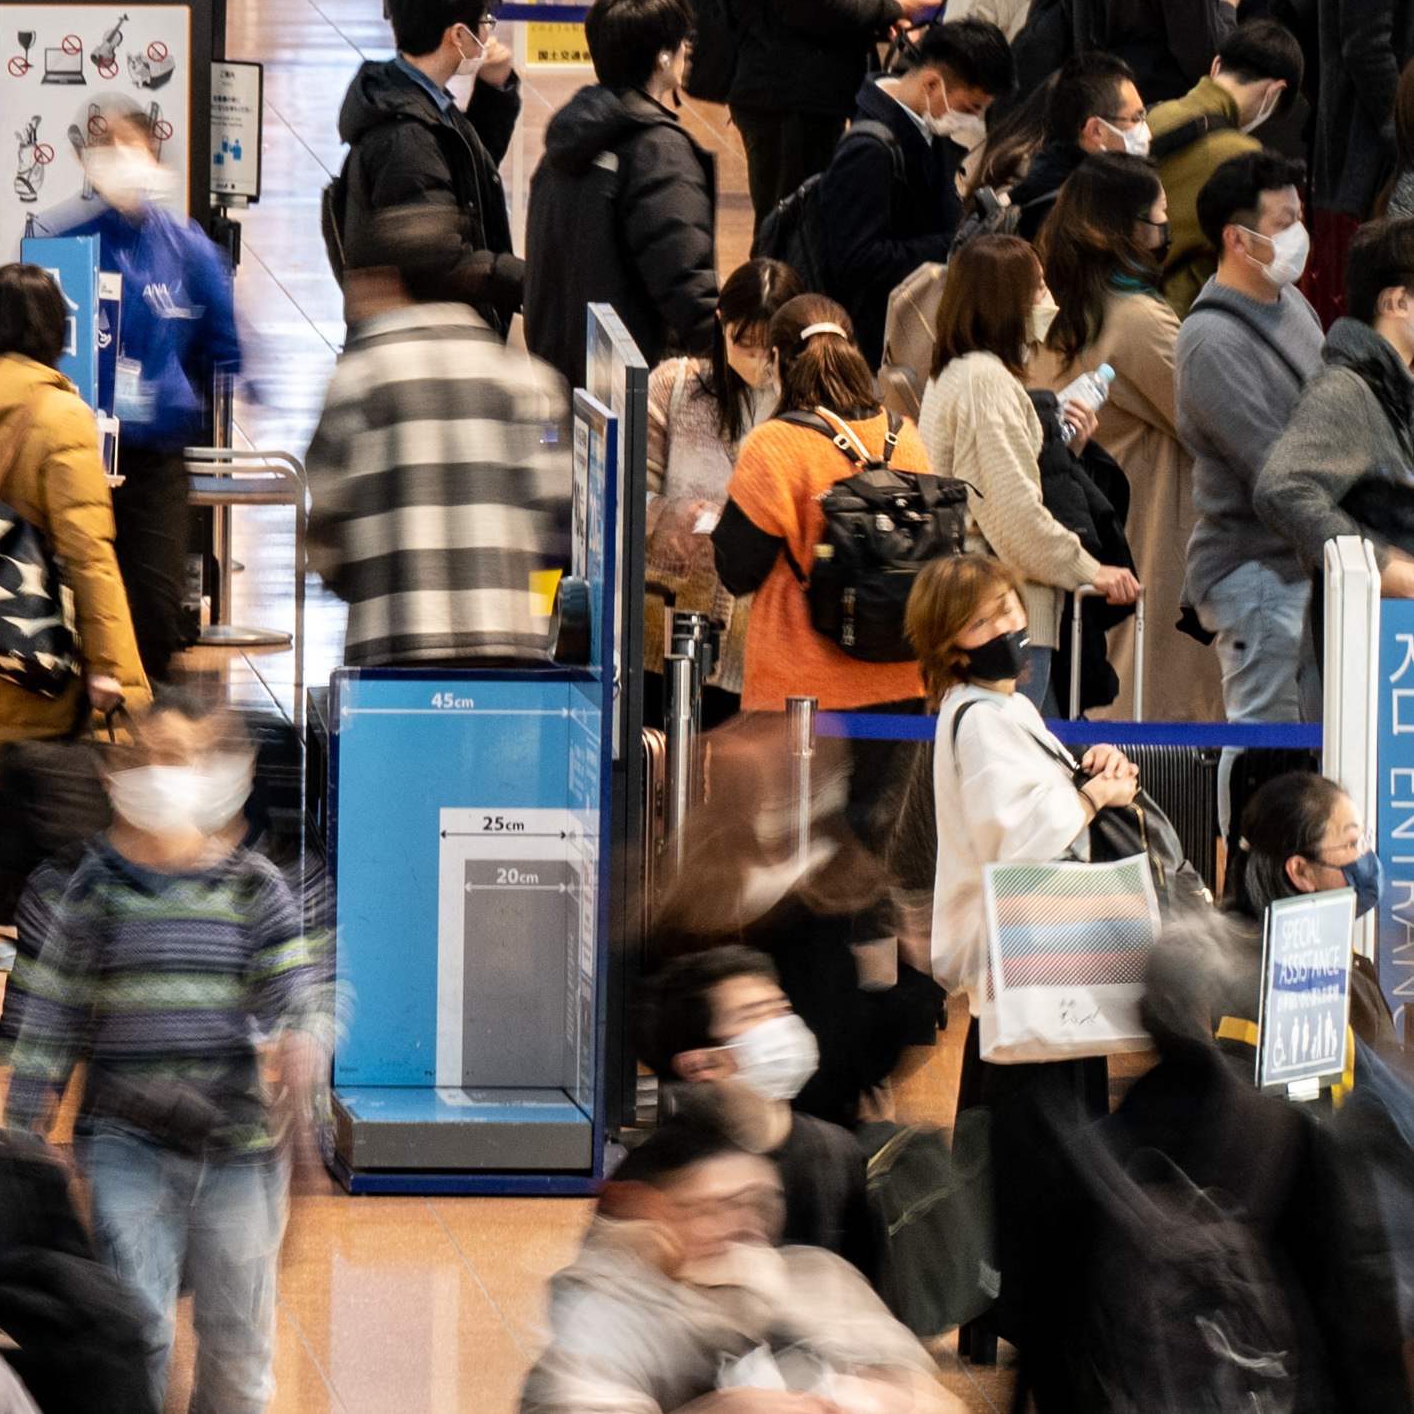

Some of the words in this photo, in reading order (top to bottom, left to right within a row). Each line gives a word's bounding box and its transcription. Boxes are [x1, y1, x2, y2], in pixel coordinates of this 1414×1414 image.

[431, 692, 474, 709] 45cm
[482, 817, 525, 831] 25cm
[496, 868, 539, 884] 20cm
[1281, 915, 1321, 951] SPECIAL
[1279, 946, 1340, 985] ASSISTANCE
